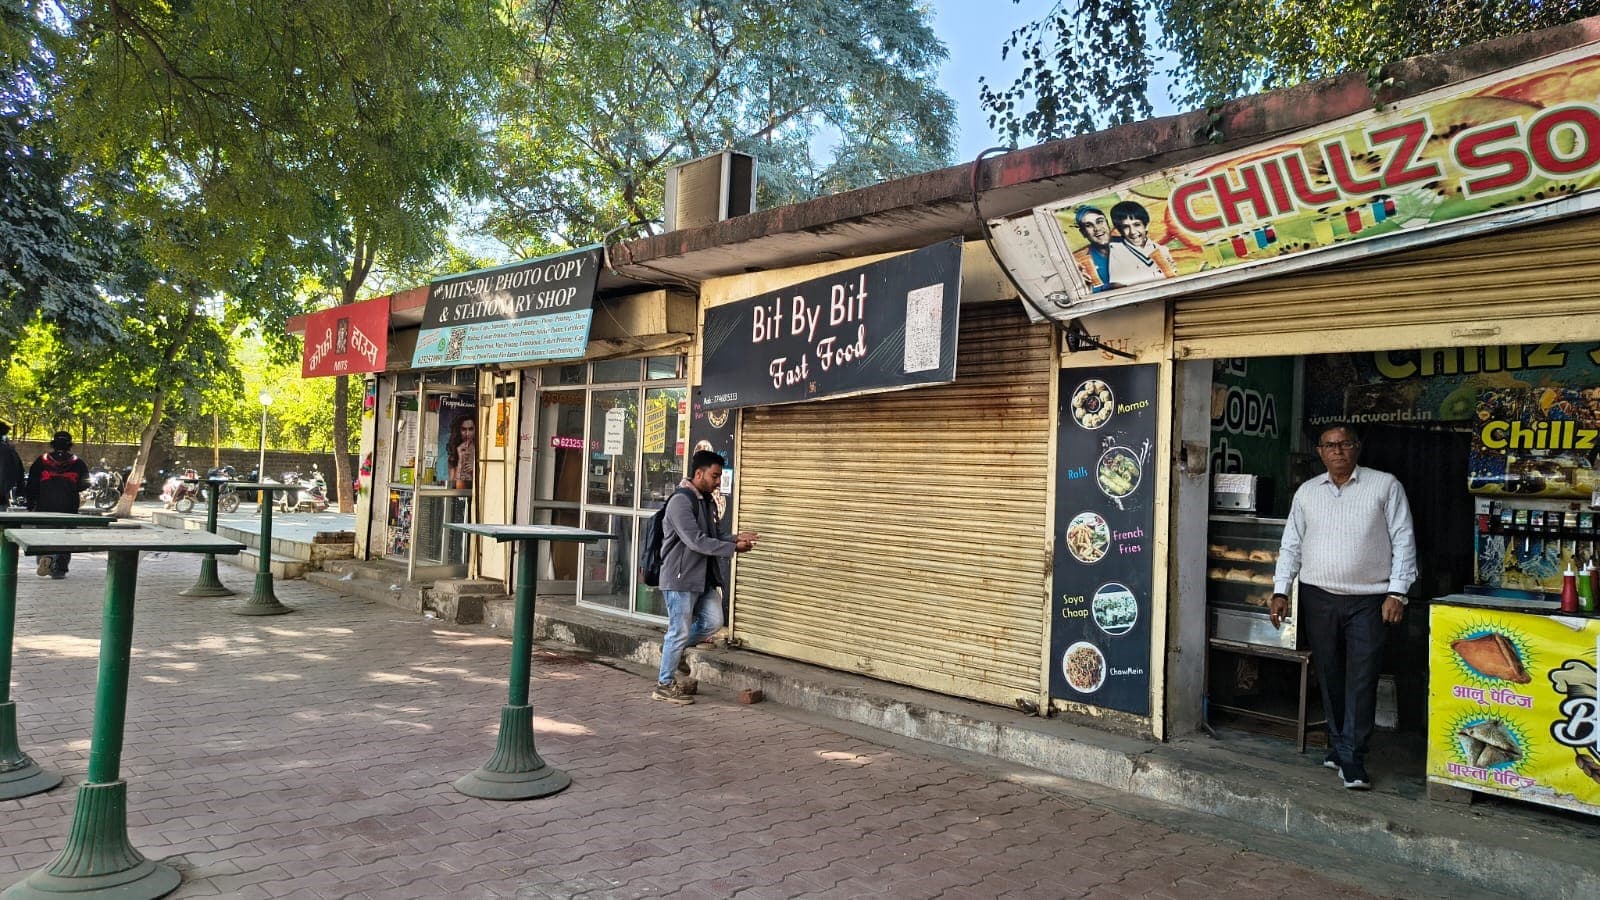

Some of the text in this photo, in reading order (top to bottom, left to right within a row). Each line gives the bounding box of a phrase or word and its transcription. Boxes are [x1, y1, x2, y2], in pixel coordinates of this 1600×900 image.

[1171, 115, 1442, 232] CHILLZ
[442, 275, 494, 301] MITS-DU
[495, 267, 542, 291] PHOTO
[544, 257, 587, 283] COPY
[439, 306, 449, 323] &
[536, 287, 577, 309] SHOP
[752, 273, 868, 343] Bit By Bit
[333, 360, 348, 371] MITS
[769, 353, 809, 390] Fast
[817, 323, 867, 372] Food
[1117, 399, 1149, 415] Momos
[1310, 407, 1432, 426] www.ncworld.in
[1481, 420, 1598, 450] Chillz
[1067, 467, 1088, 480] Rolls
[1113, 528, 1144, 540] French
[1119, 543, 1141, 554] Fries
[1063, 594, 1084, 606] Soya
[1062, 607, 1089, 619] Chaap
[1453, 685, 1490, 706] आलू
[1446, 762, 1488, 782] पास्ता
